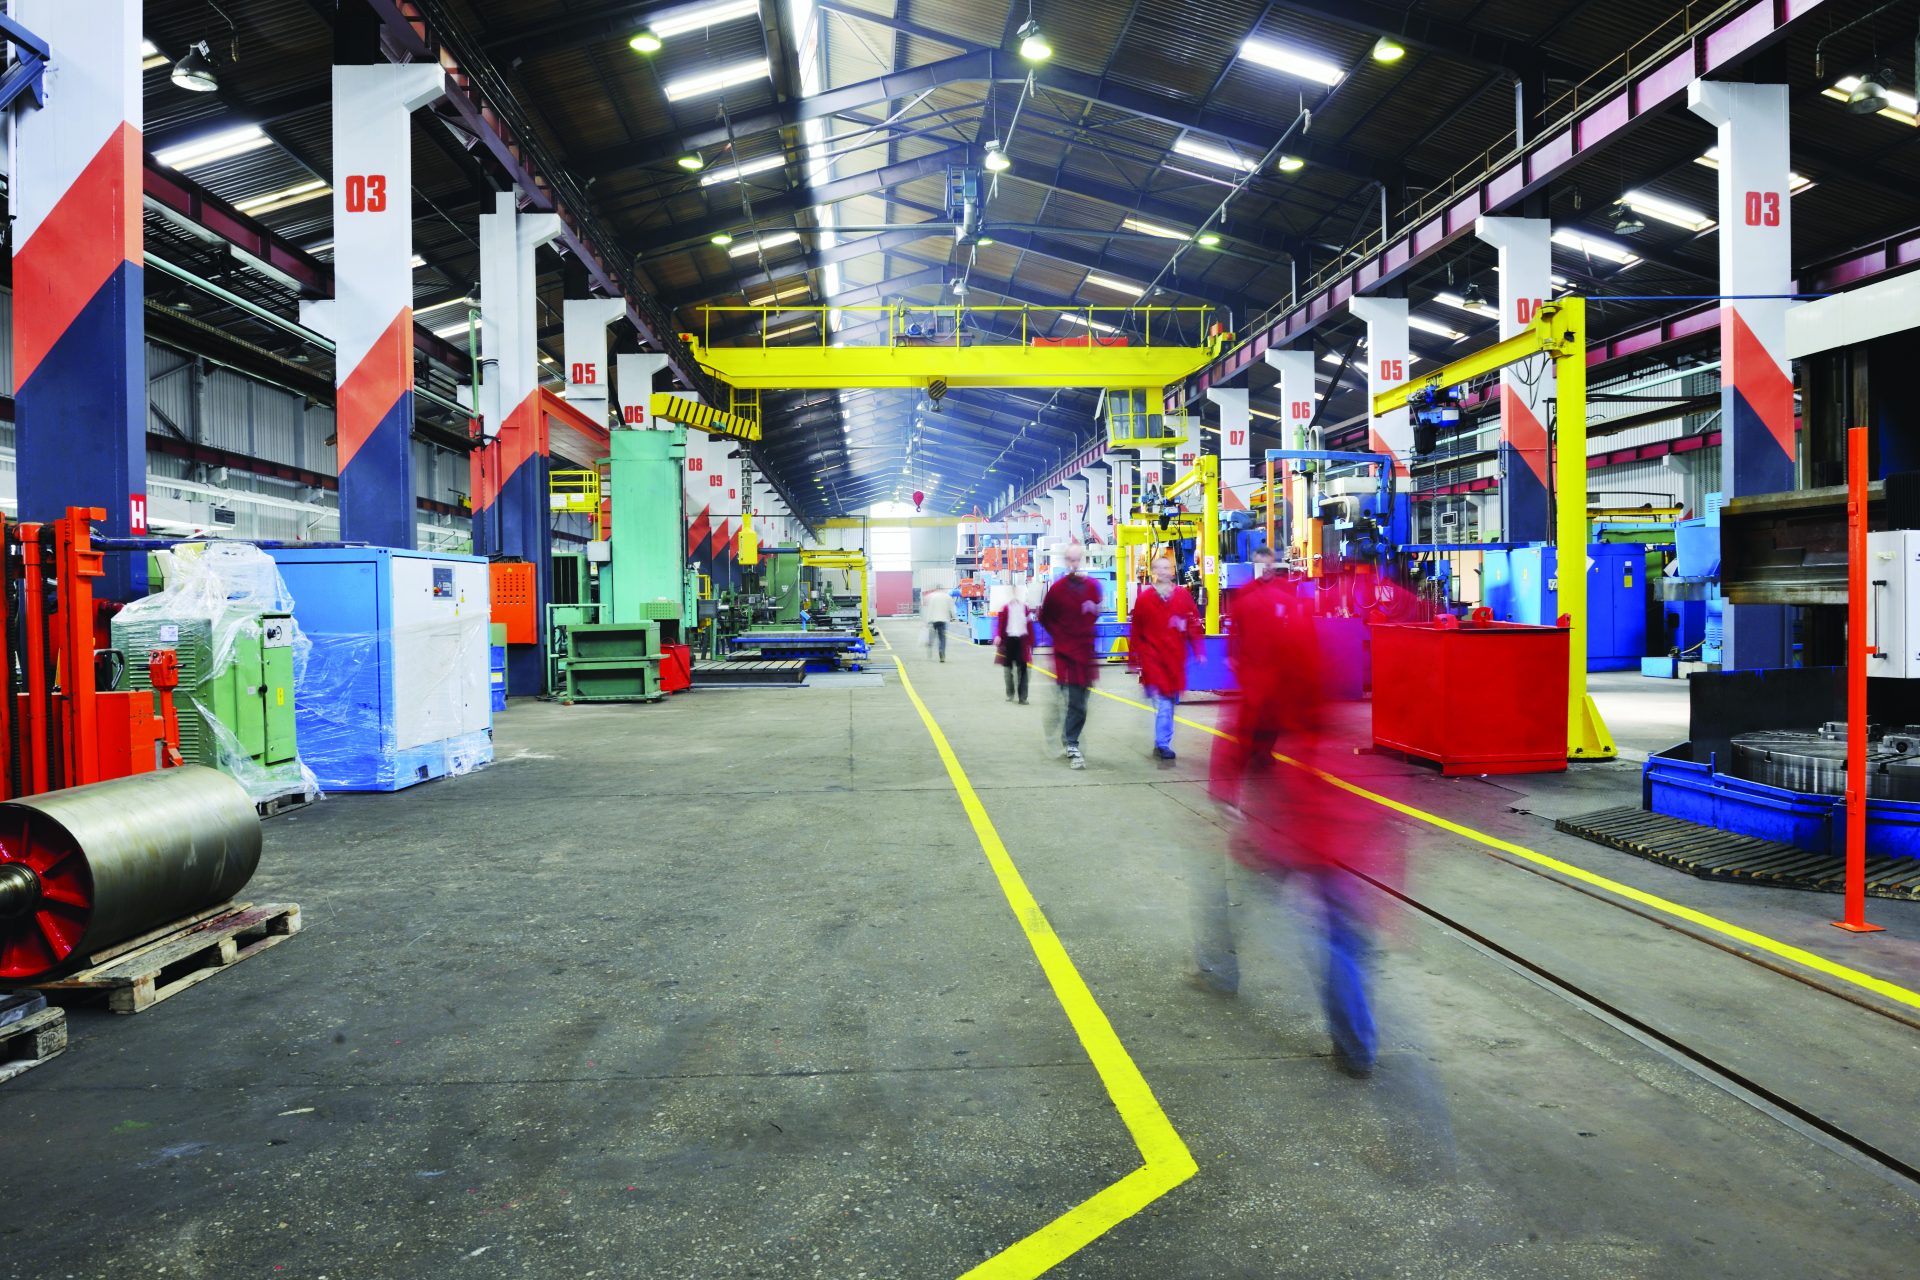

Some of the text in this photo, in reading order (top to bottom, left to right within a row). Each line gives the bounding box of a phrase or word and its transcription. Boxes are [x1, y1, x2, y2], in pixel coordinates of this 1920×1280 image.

[346, 175, 386, 212] 03
[1745, 191, 1779, 226] 03
[573, 363, 595, 384] 05
[1381, 360, 1402, 380] 05
[625, 406, 643, 423] 06
[1292, 402, 1310, 418] 06
[1230, 431, 1244, 445] 07
[689, 458, 702, 471] 08
[710, 475, 722, 486] 09
[1147, 472, 1158, 483] 09
[1097, 496, 1104, 504] 11
[131, 500, 144, 528] H
[1076, 505, 1083, 513] 12
